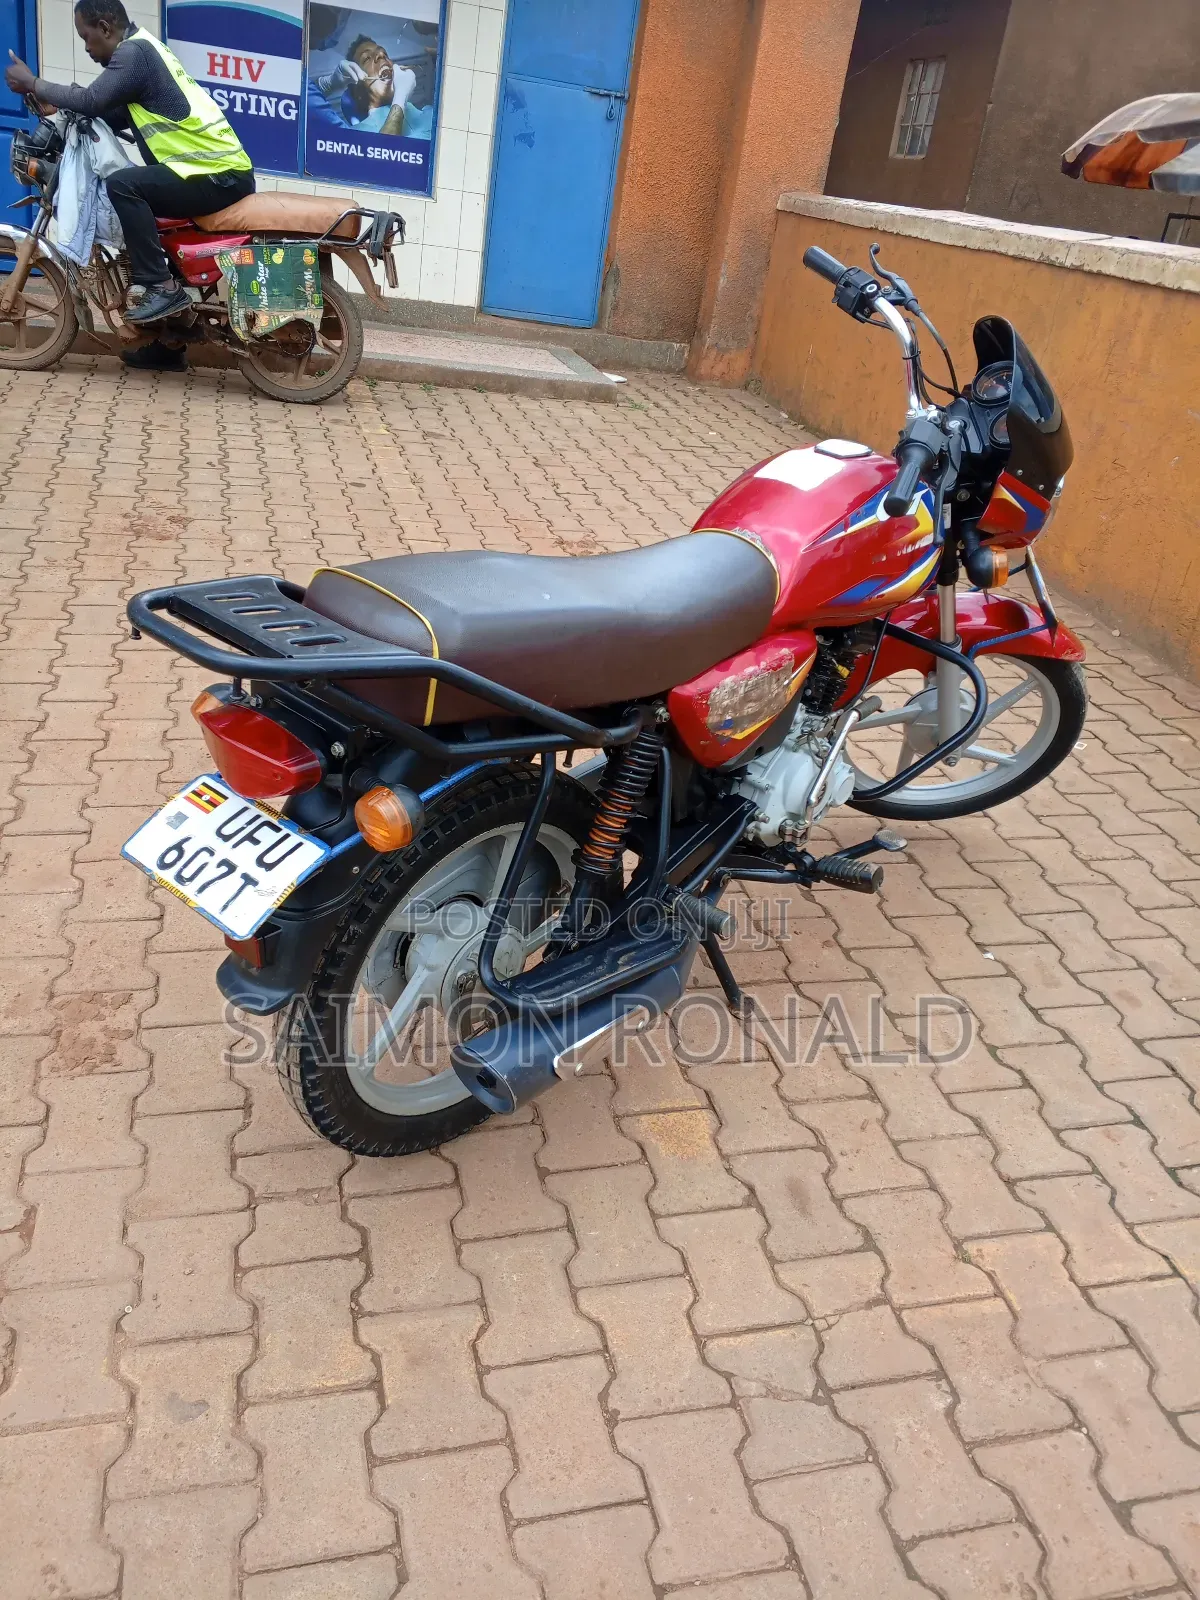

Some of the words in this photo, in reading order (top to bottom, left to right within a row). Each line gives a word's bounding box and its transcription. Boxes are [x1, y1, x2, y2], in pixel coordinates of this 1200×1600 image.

[207, 52, 266, 83] HIV
[205, 87, 298, 121] STING
[316, 139, 364, 157] DENTAL
[367, 146, 423, 165] SERVICES
[256, 260, 267, 284] Star
[215, 806, 304, 872] UFU
[156, 835, 259, 914] 607T
